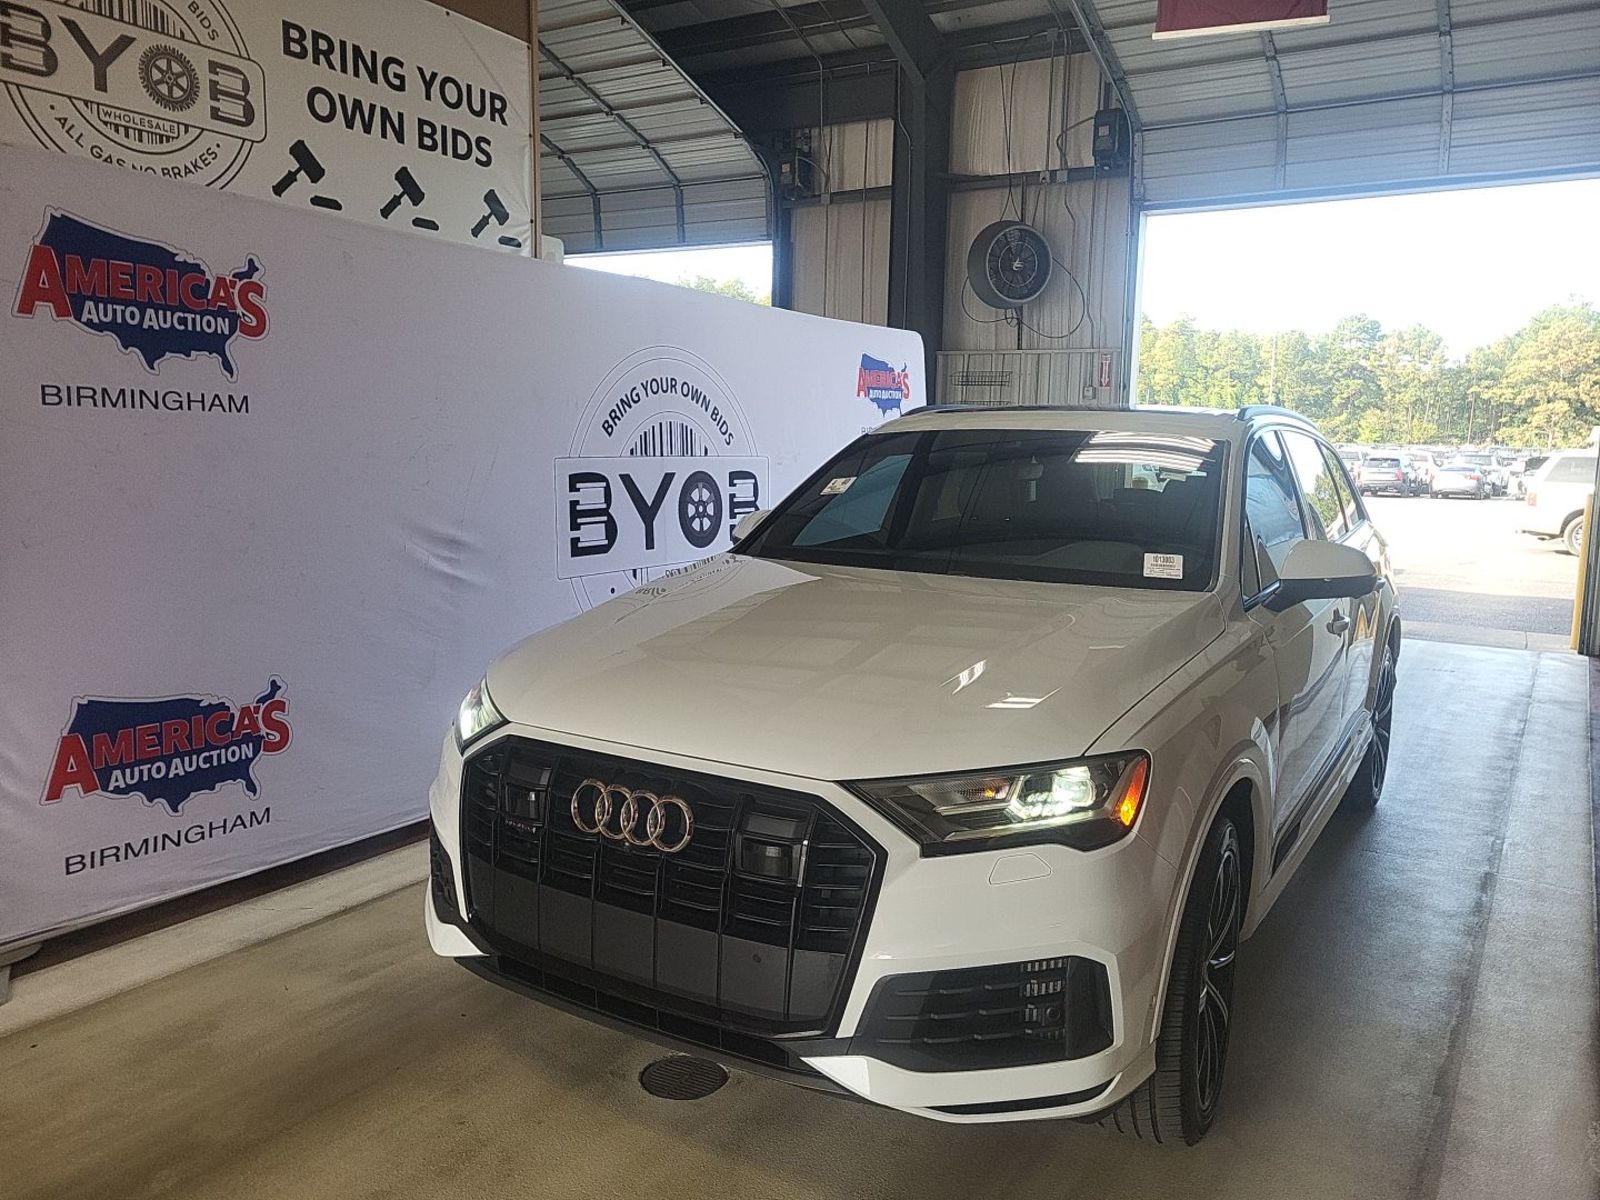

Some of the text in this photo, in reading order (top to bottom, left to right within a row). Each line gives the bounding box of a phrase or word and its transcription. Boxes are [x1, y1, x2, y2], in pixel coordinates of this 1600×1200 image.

[188, 1, 219, 41] BIDS
[0, 2, 255, 127] BYOB
[282, 19, 508, 126] BRING YOUR
[54, 115, 84, 148] ALL
[161, 147, 218, 179] BRAKES
[102, 109, 176, 134] WHOLESALE
[307, 86, 493, 168] OWN BIDS
[81, 301, 230, 335] AUTO AUCTION
[41, 384, 249, 414] BIRMINGHAM
[601, 376, 734, 446] BRING YOUR OWN BIDS
[108, 742, 253, 791] AUTO AUCTION
[65, 807, 271, 875] BIRMINGHAM
